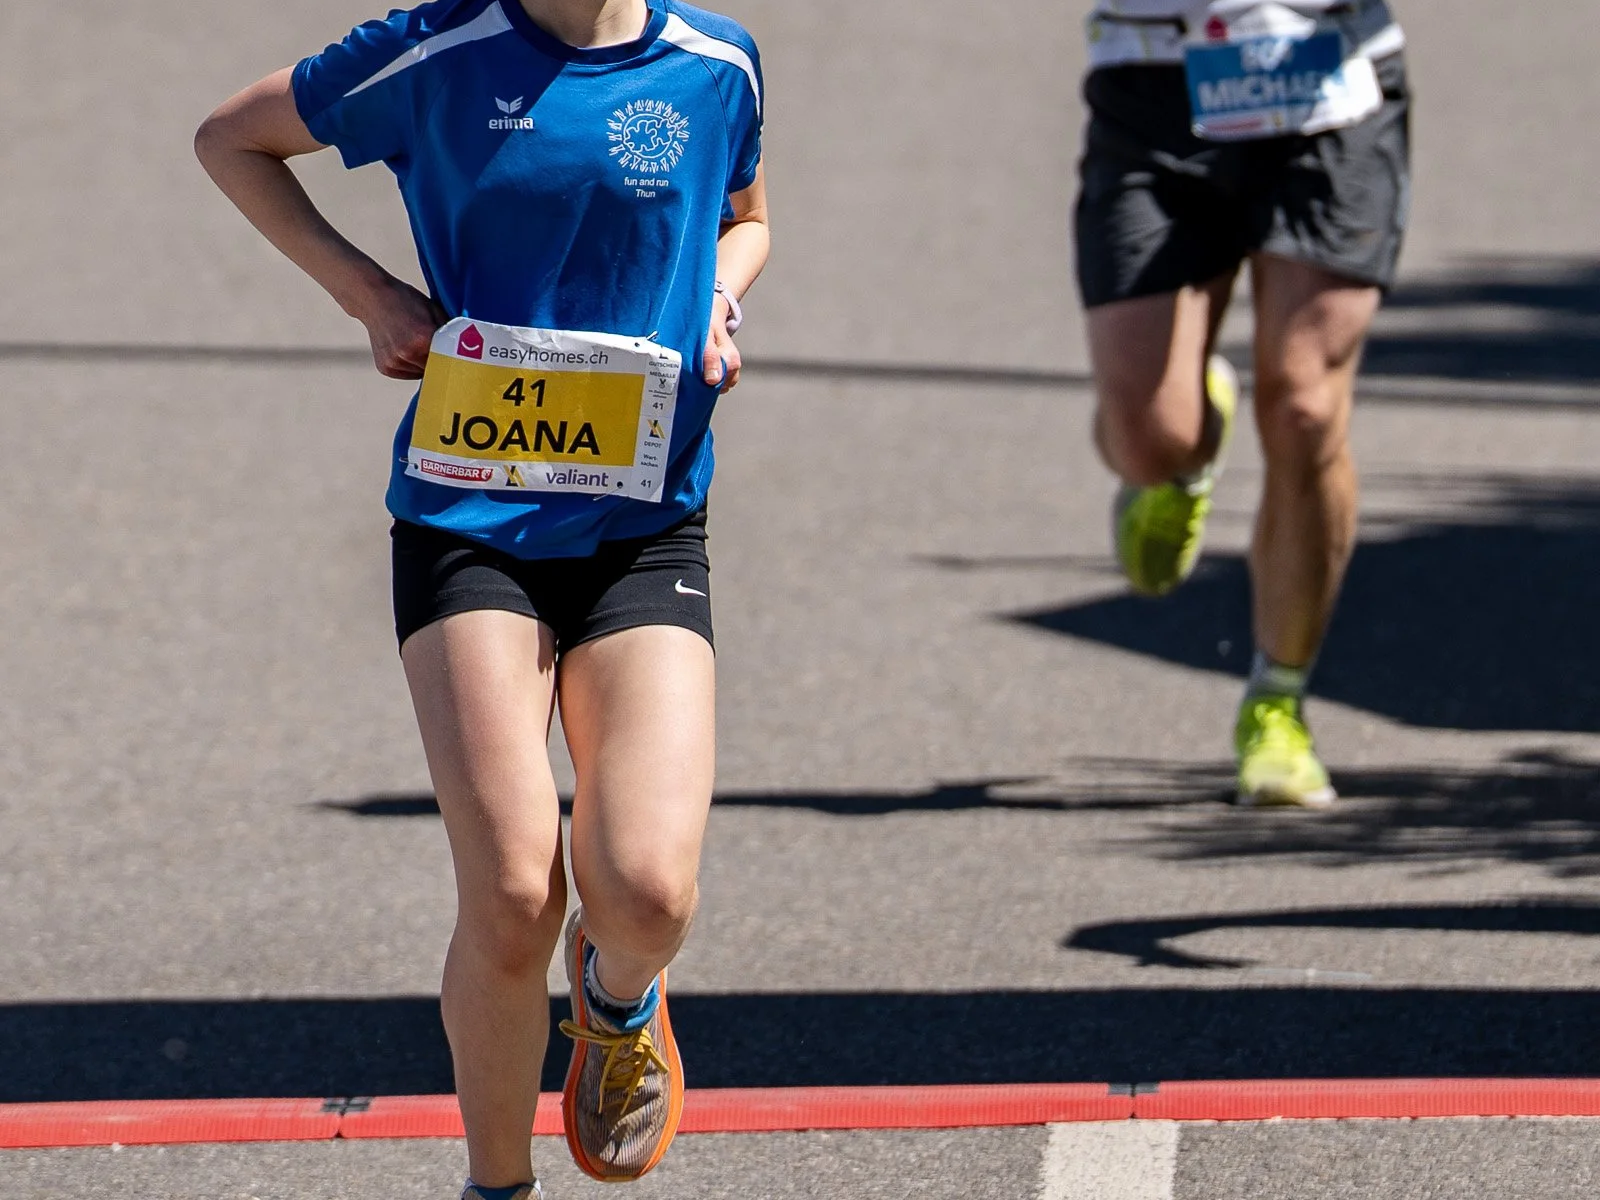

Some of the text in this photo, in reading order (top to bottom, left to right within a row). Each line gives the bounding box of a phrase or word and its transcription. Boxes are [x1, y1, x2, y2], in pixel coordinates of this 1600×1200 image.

[488, 115, 535, 130] erima
[624, 176, 669, 187] fun and run
[635, 188, 656, 198] Thun
[488, 345, 609, 365] easyhomes.ch
[502, 377, 546, 408] 41
[652, 402, 664, 410] 41
[439, 412, 601, 456] JOANA
[546, 469, 609, 488] valiant
[640, 479, 652, 488] 41
